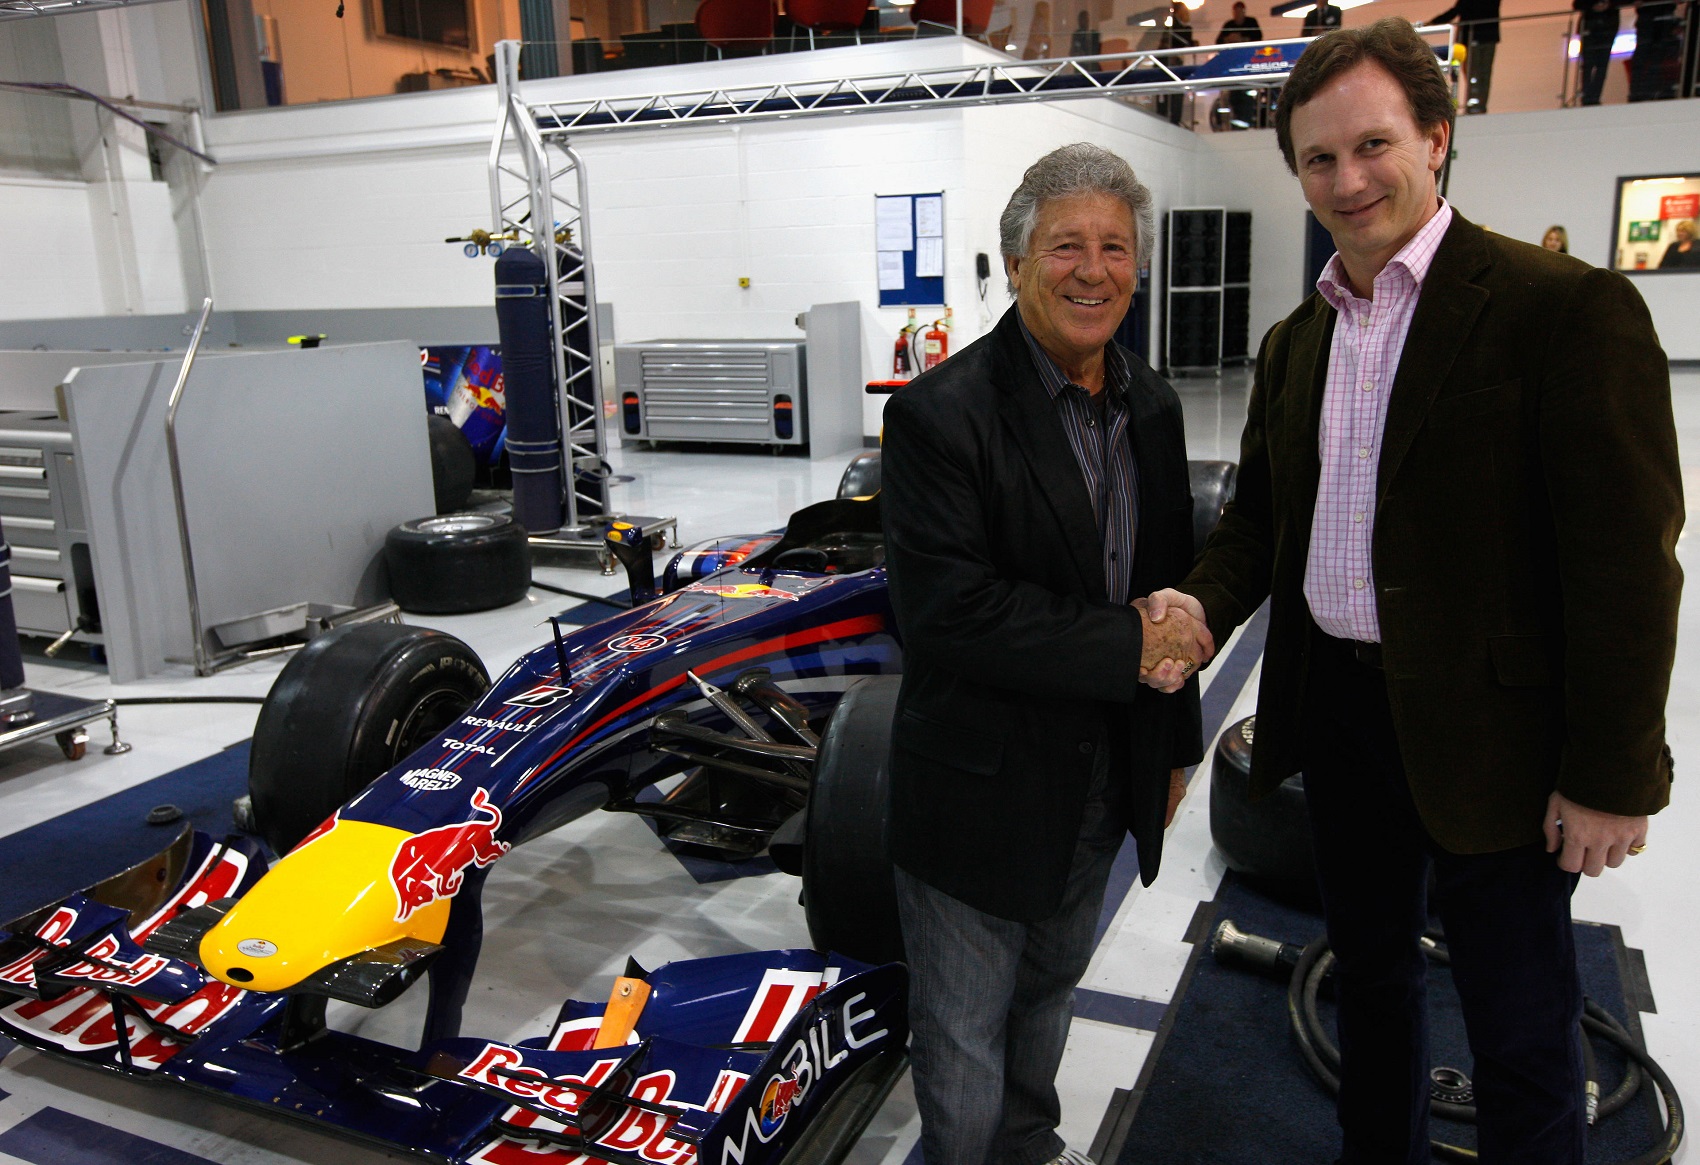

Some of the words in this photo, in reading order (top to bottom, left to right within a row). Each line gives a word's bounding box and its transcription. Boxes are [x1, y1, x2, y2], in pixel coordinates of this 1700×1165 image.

[616, 636, 659, 650] 14
[461, 715, 537, 732] RENAULT
[442, 738, 496, 755] TOTAL
[457, 1042, 622, 1116] Red
